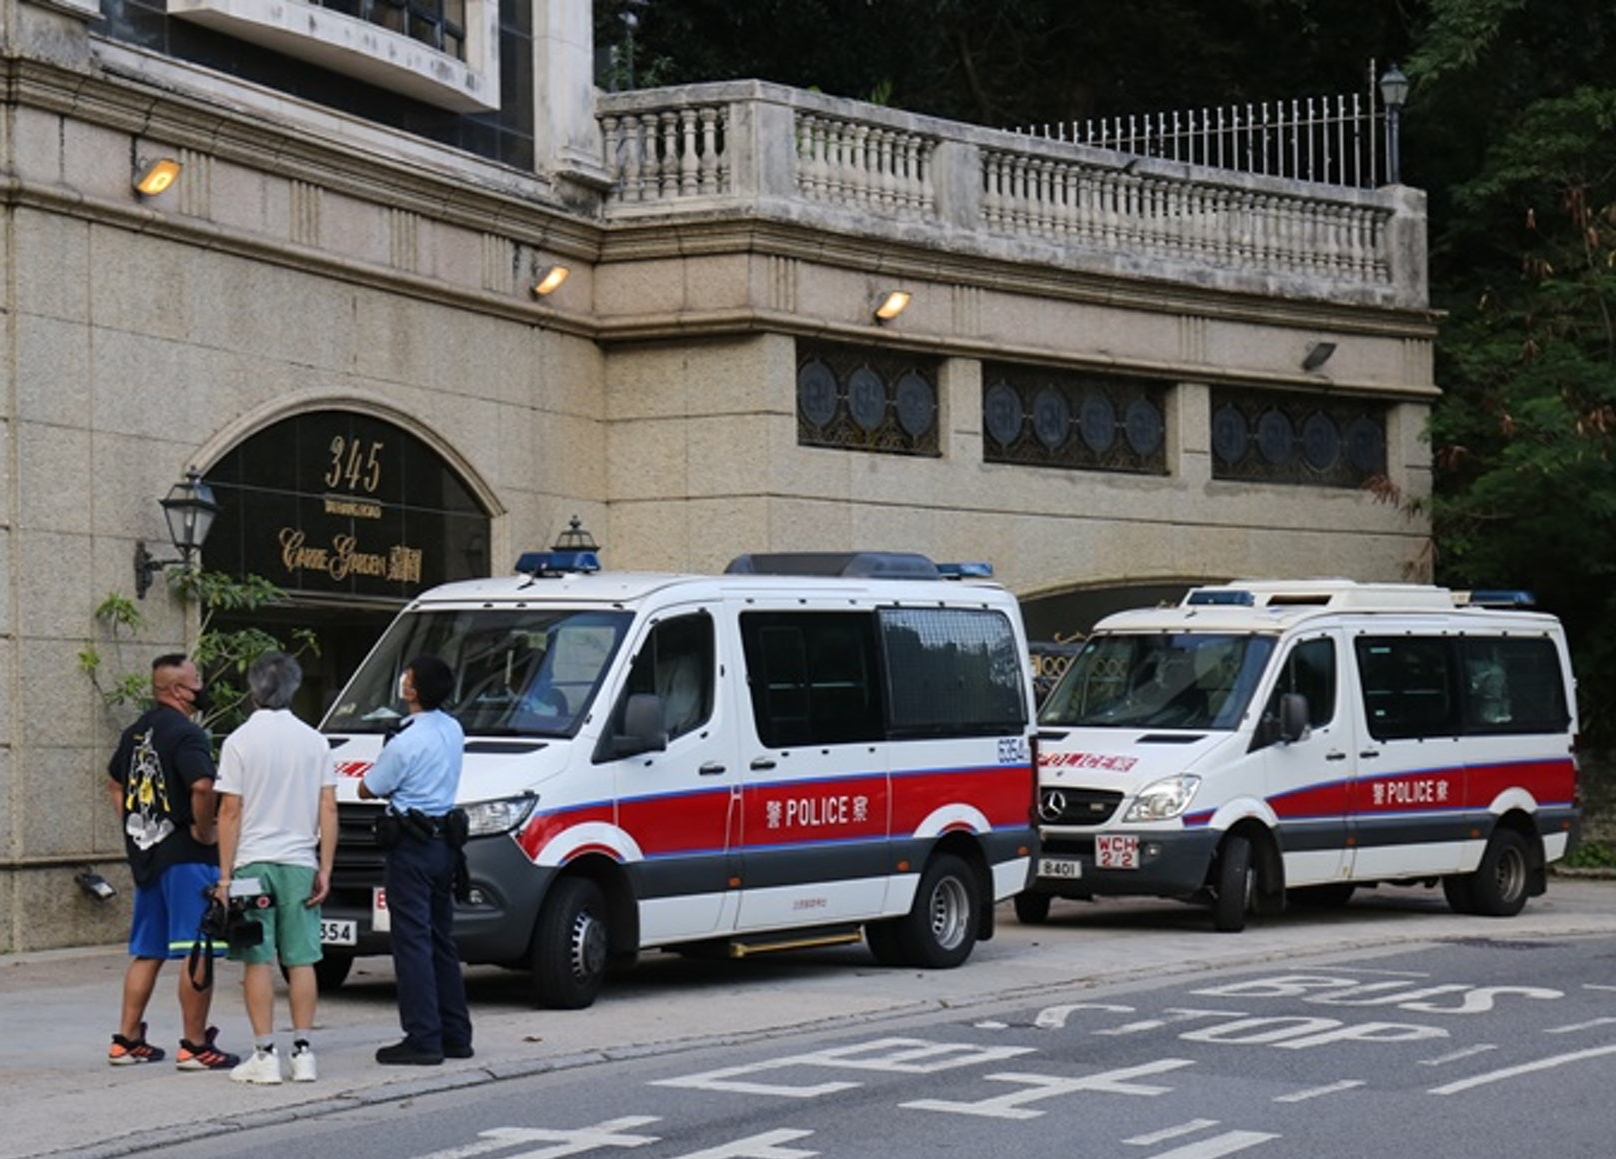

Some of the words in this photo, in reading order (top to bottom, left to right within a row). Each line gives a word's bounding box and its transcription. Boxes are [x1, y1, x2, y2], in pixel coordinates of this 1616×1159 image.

[325, 435, 384, 492] 345
[1387, 780, 1434, 804] POLICE
[766, 800, 781, 829] 警
[786, 796, 849, 828] POLICE
[853, 796, 868, 823] 察
[1098, 836, 1136, 852] WCH
[1190, 975, 1566, 1014] BUS
